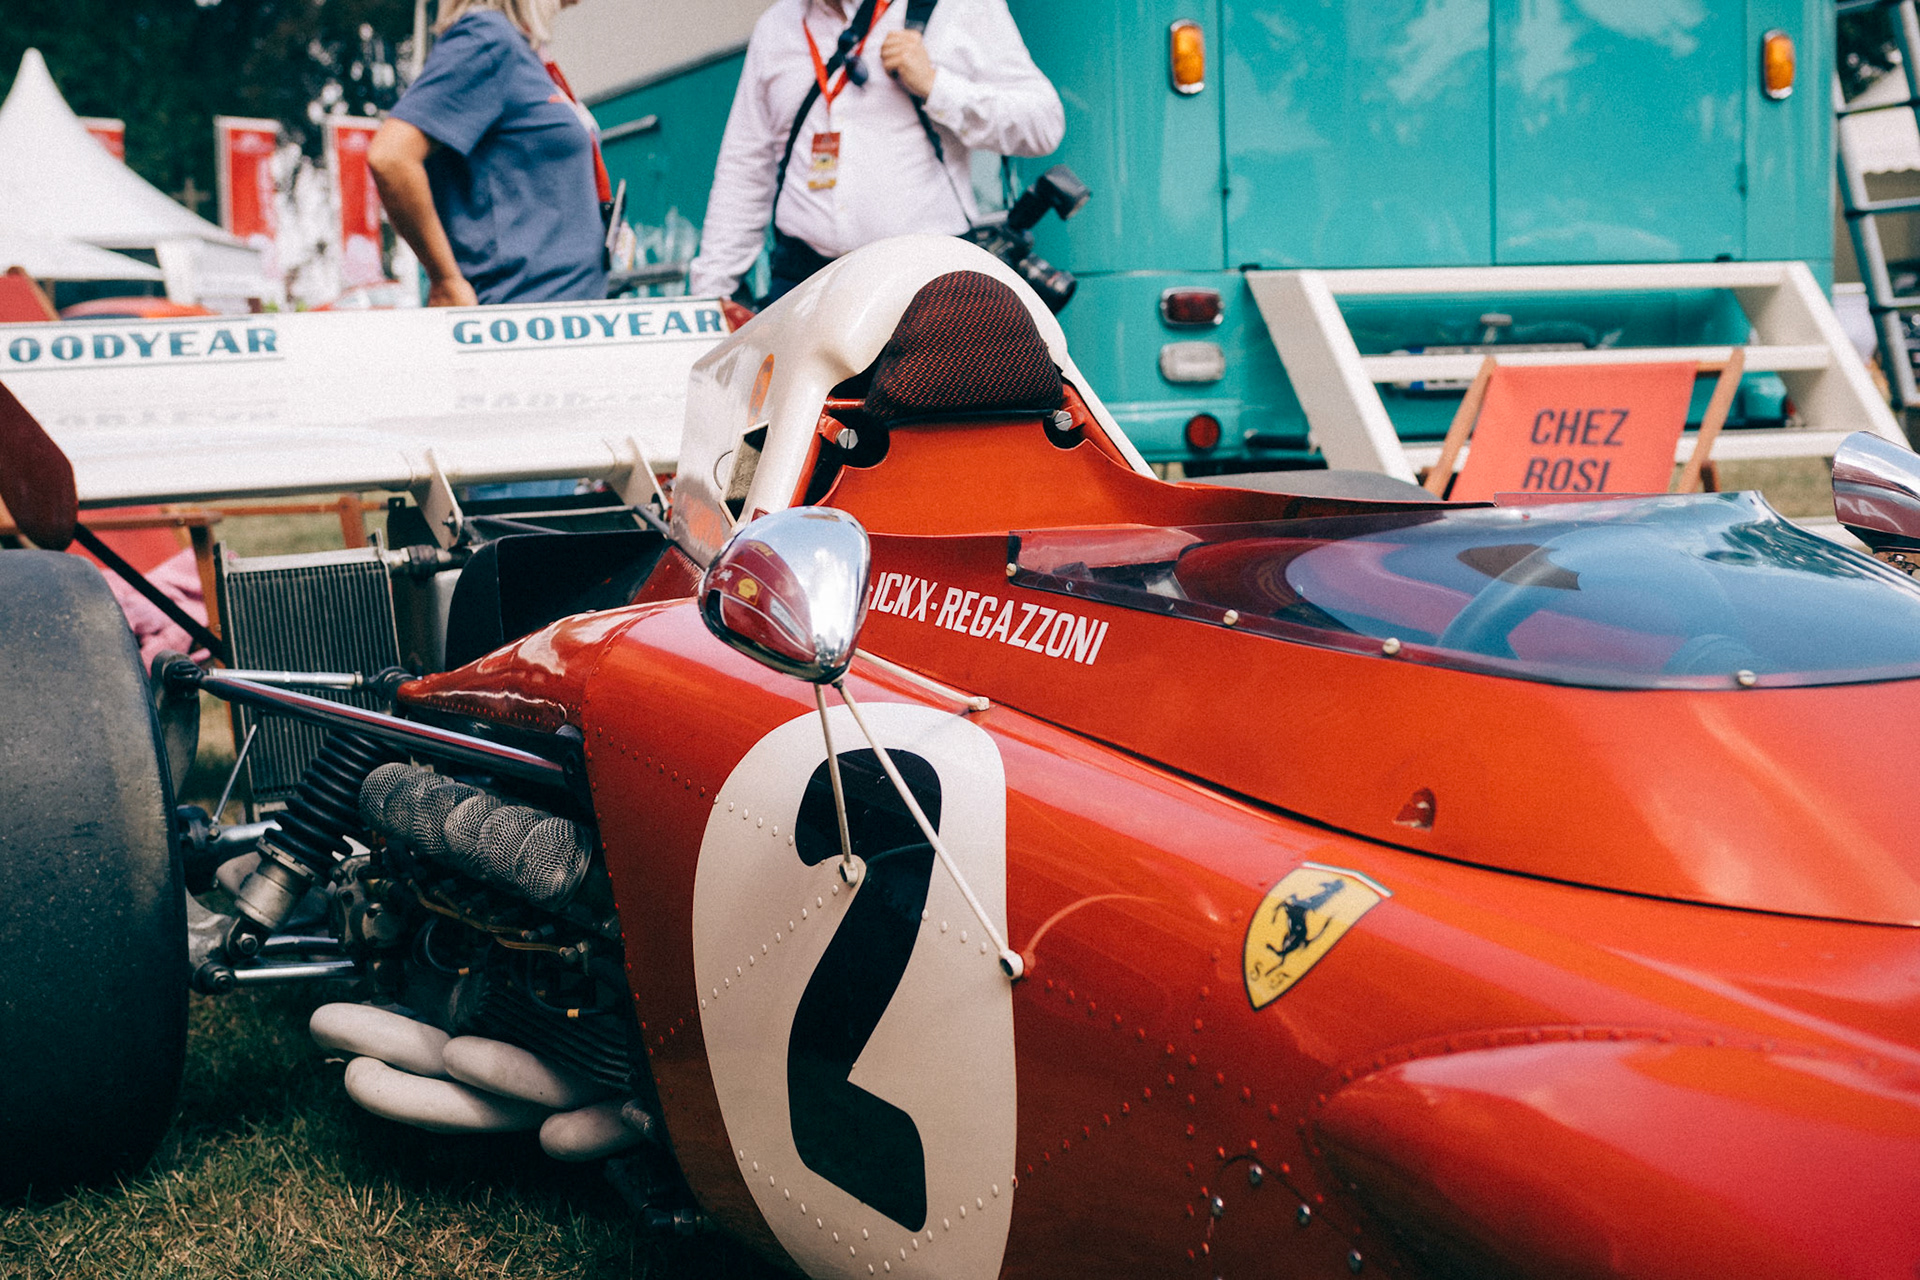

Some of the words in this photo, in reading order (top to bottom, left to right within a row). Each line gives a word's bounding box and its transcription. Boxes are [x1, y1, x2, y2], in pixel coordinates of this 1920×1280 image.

[452, 309, 722, 344] GOODYEAR
[8, 327, 278, 363] OODYEAR
[1531, 408, 1629, 446] CHEZ
[1522, 457, 1611, 492] ROSI
[787, 748, 941, 1233] 2
